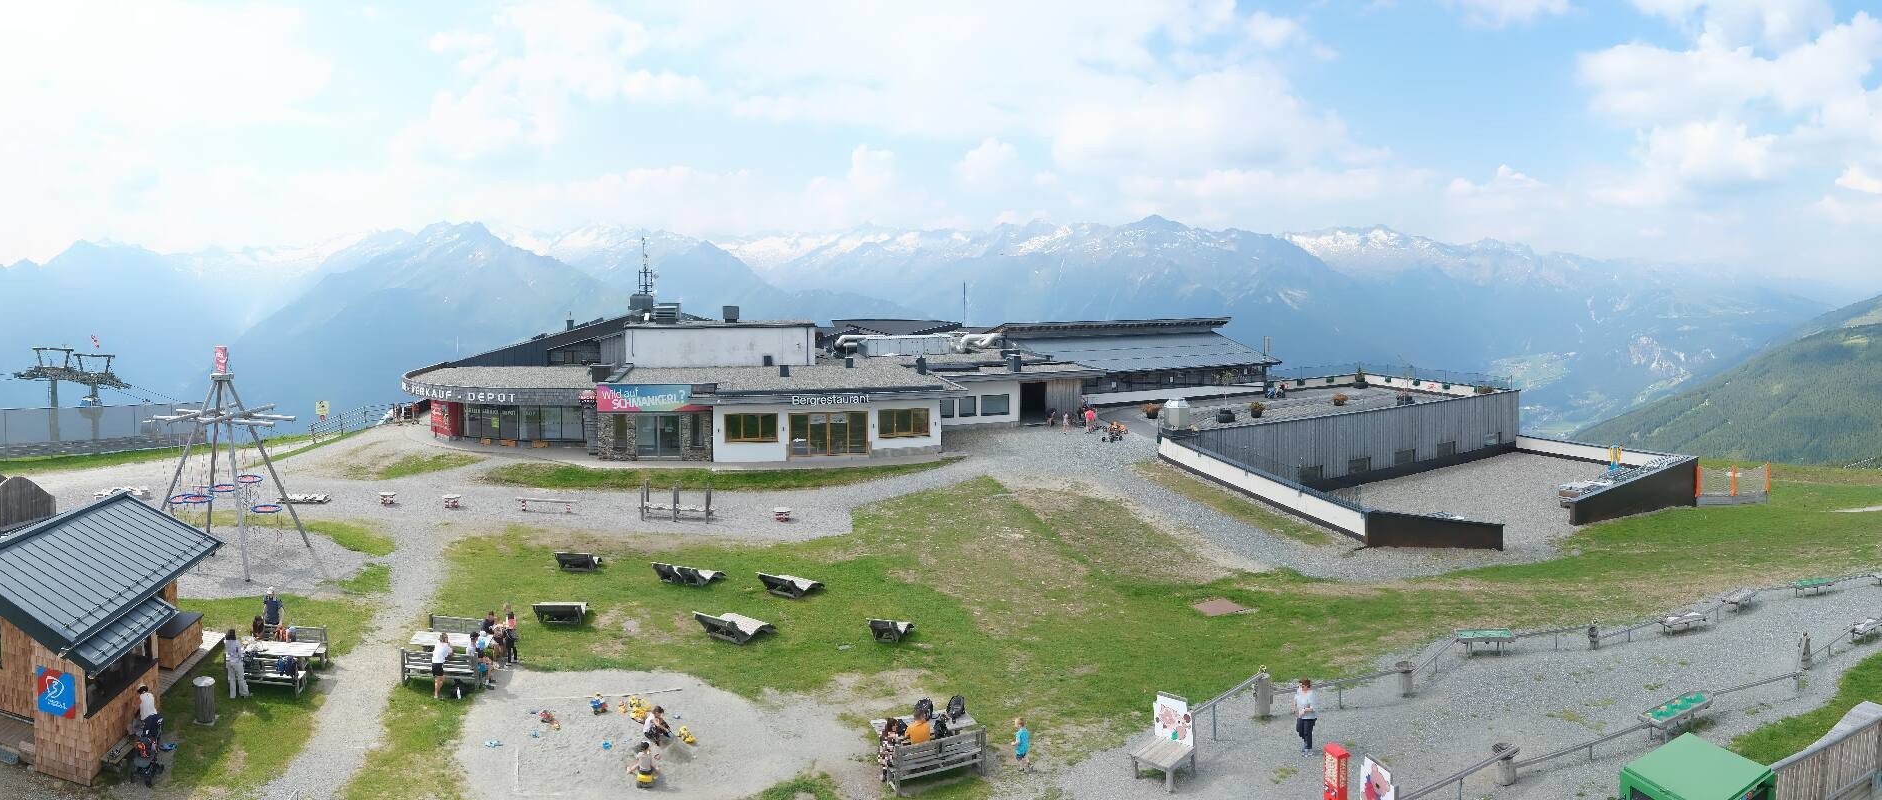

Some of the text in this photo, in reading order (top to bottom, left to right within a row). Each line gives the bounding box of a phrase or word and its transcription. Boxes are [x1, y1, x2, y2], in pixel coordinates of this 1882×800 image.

[468, 391, 516, 403] DEPOT
[602, 387, 639, 399] Wild auf
[791, 394, 870, 406] Bergrestaurant
